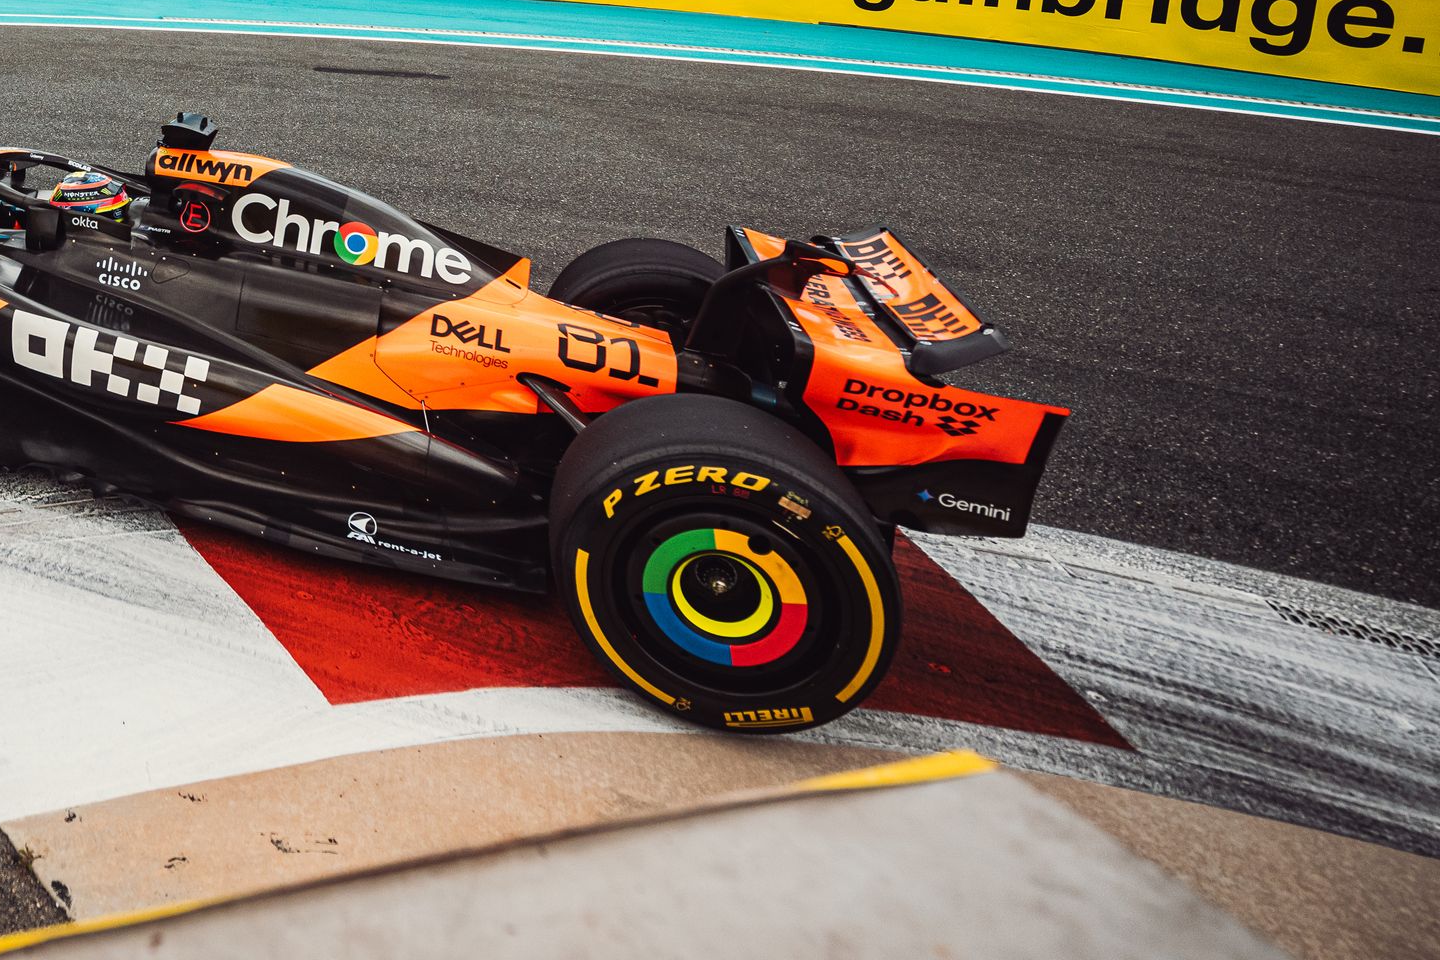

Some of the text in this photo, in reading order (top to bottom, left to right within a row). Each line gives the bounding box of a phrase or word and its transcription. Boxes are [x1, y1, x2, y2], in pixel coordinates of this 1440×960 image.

[158, 153, 253, 183] allwyn
[71, 215, 99, 230] okta
[231, 192, 472, 285] Chrome
[430, 314, 511, 353] DELL
[429, 339, 509, 369] Technologies
[836, 397, 926, 427] Dash
[844, 378, 1001, 422] Dropbox
[602, 465, 772, 519] P ZERO
[938, 492, 1011, 522] Gemini
[378, 540, 442, 561] rent-a-jet
[723, 706, 815, 728] PIRELLI
